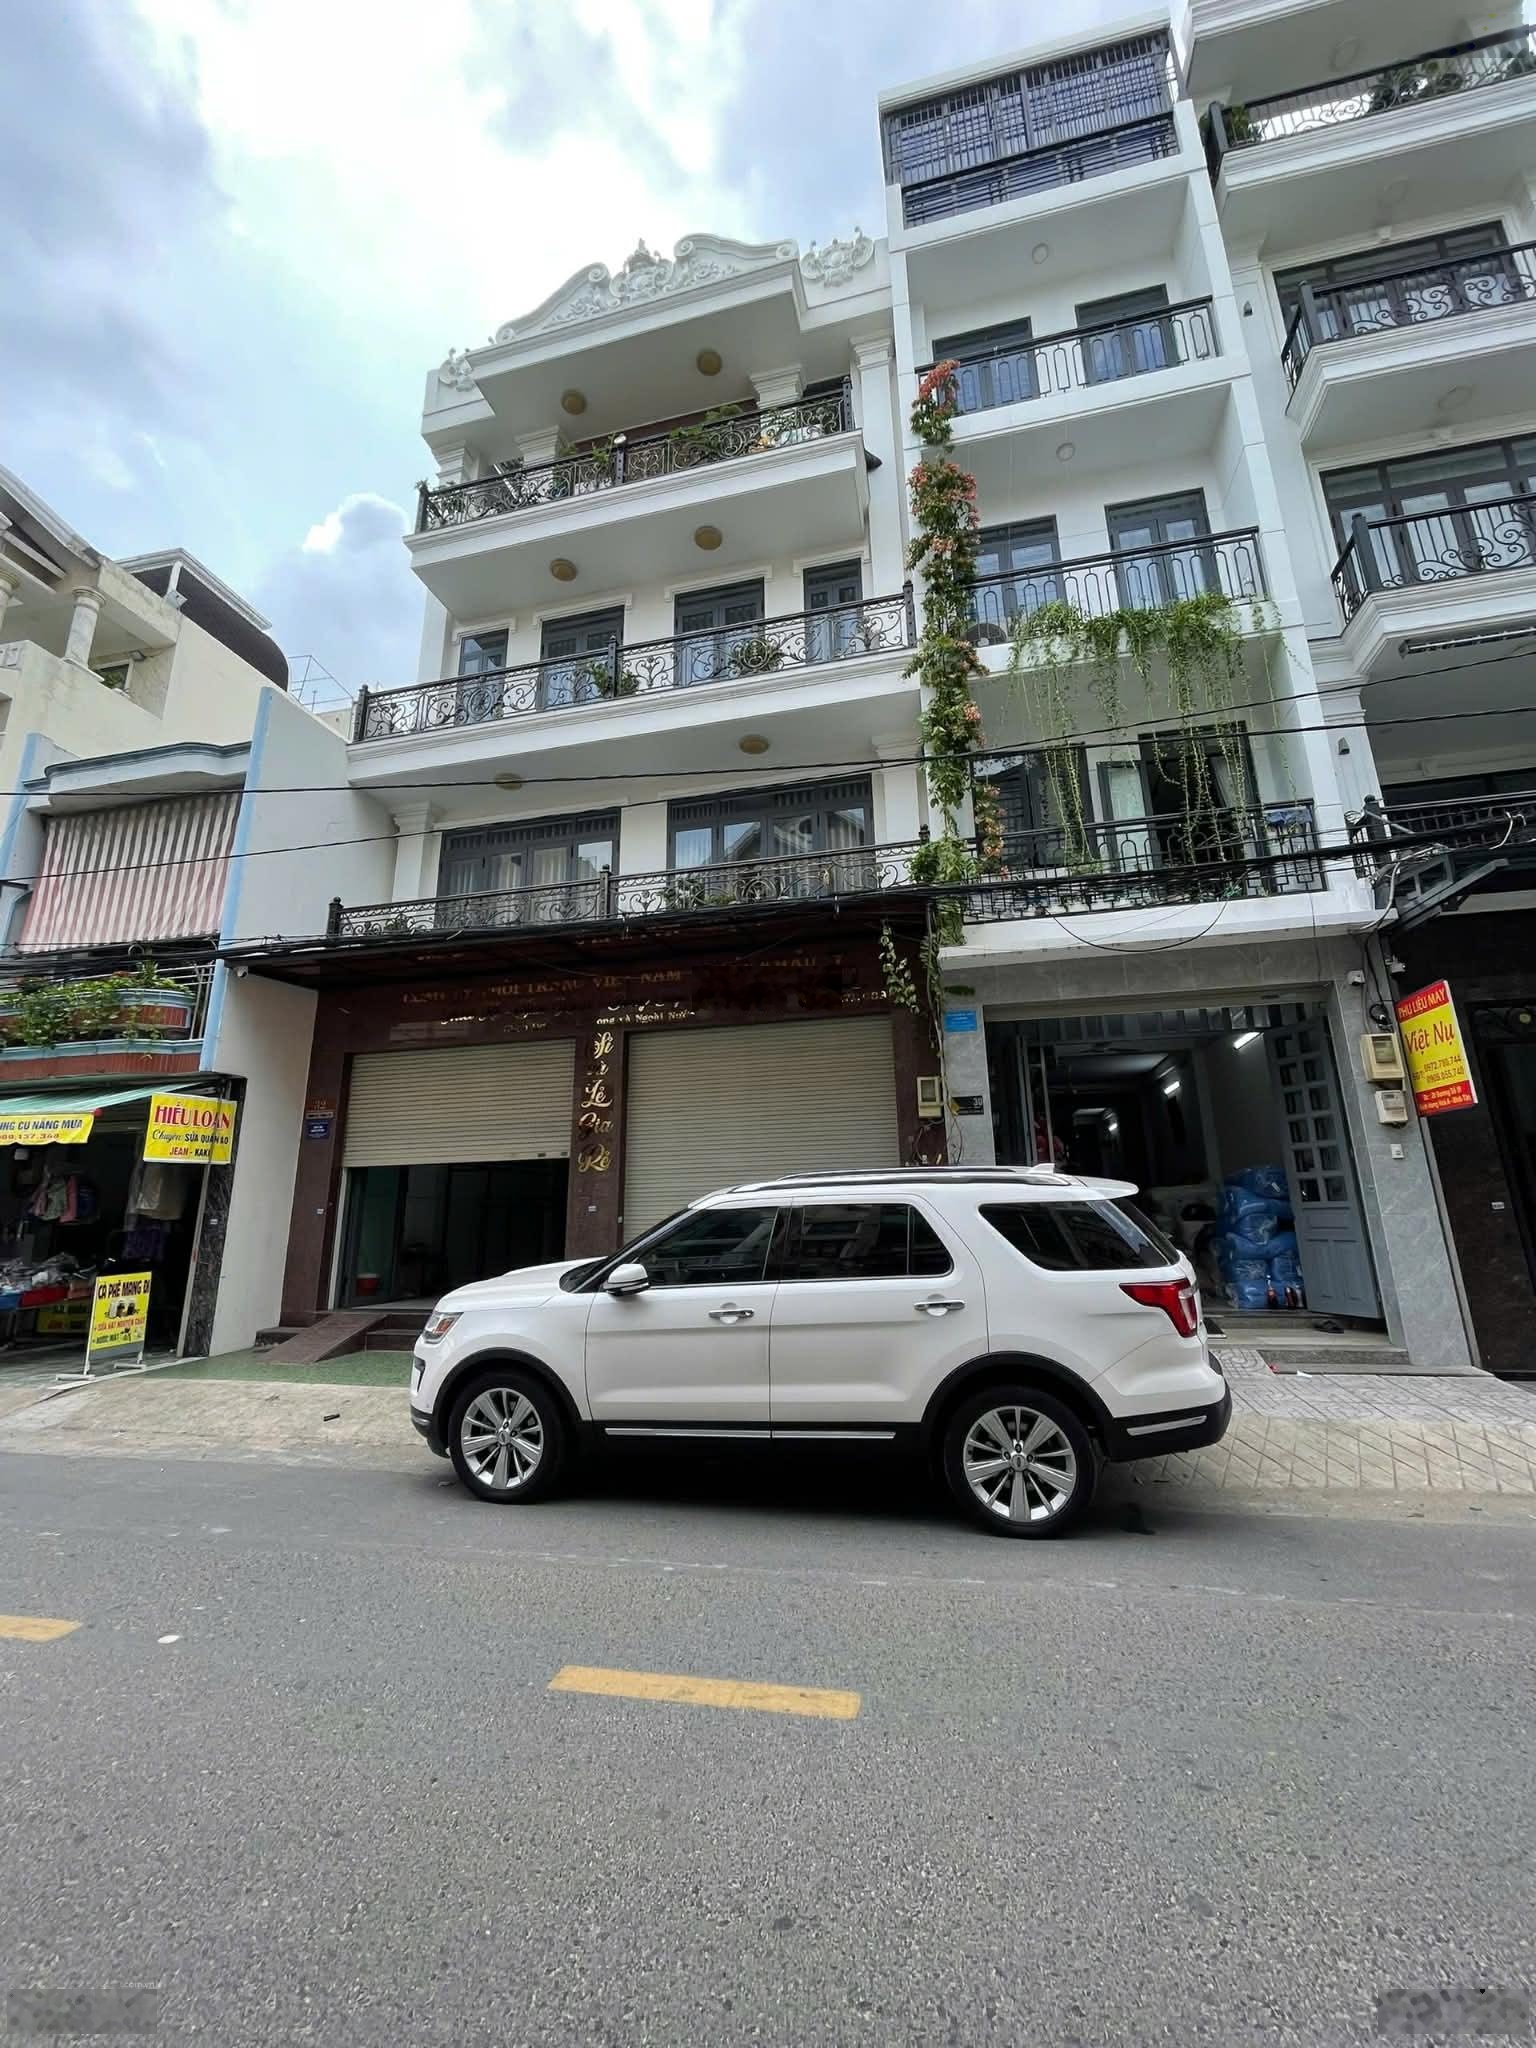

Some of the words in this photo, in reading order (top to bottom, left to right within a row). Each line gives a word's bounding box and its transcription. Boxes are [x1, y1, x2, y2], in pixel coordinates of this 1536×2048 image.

[1427, 987, 1446, 1007] MAY
[1405, 1028, 1430, 1055] Việt
[1433, 1020, 1455, 1046] Nụ
[193, 1109, 230, 1129] LOAN
[169, 1147, 189, 1156] JEAN
